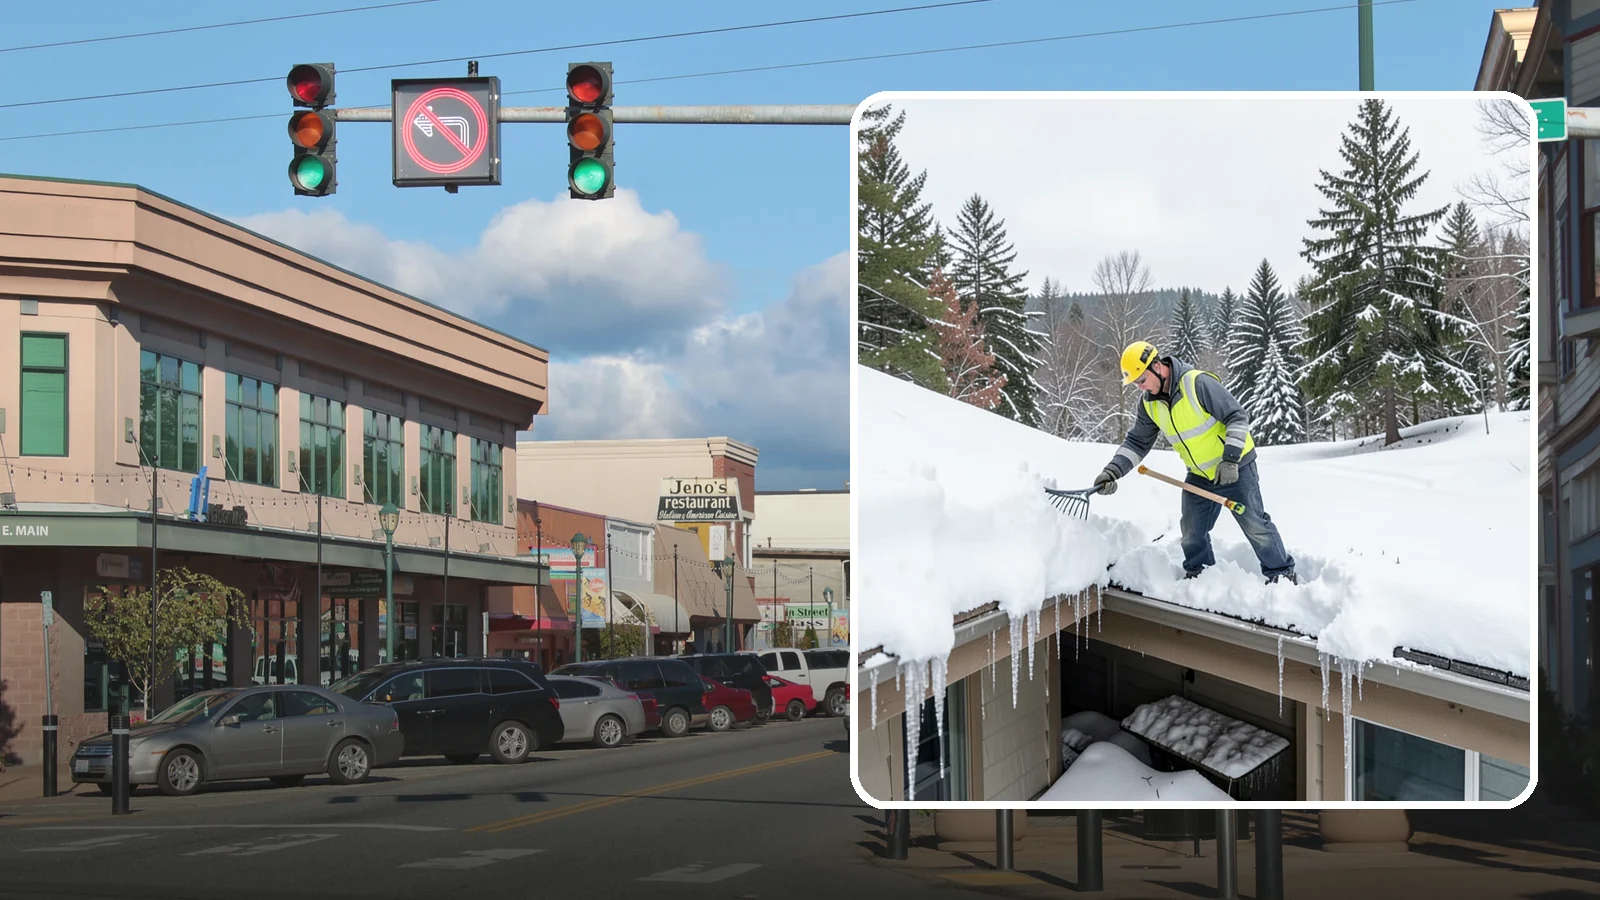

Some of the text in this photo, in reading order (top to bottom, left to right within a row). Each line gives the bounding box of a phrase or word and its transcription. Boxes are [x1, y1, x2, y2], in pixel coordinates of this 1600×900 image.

[670, 480, 727, 494] Jeno's
[665, 496, 731, 509] restaurant
[686, 509, 715, 519] American
[715, 509, 738, 519] Cuisine
[2, 525, 49, 536] E. MAIN
[797, 607, 828, 616] Street
